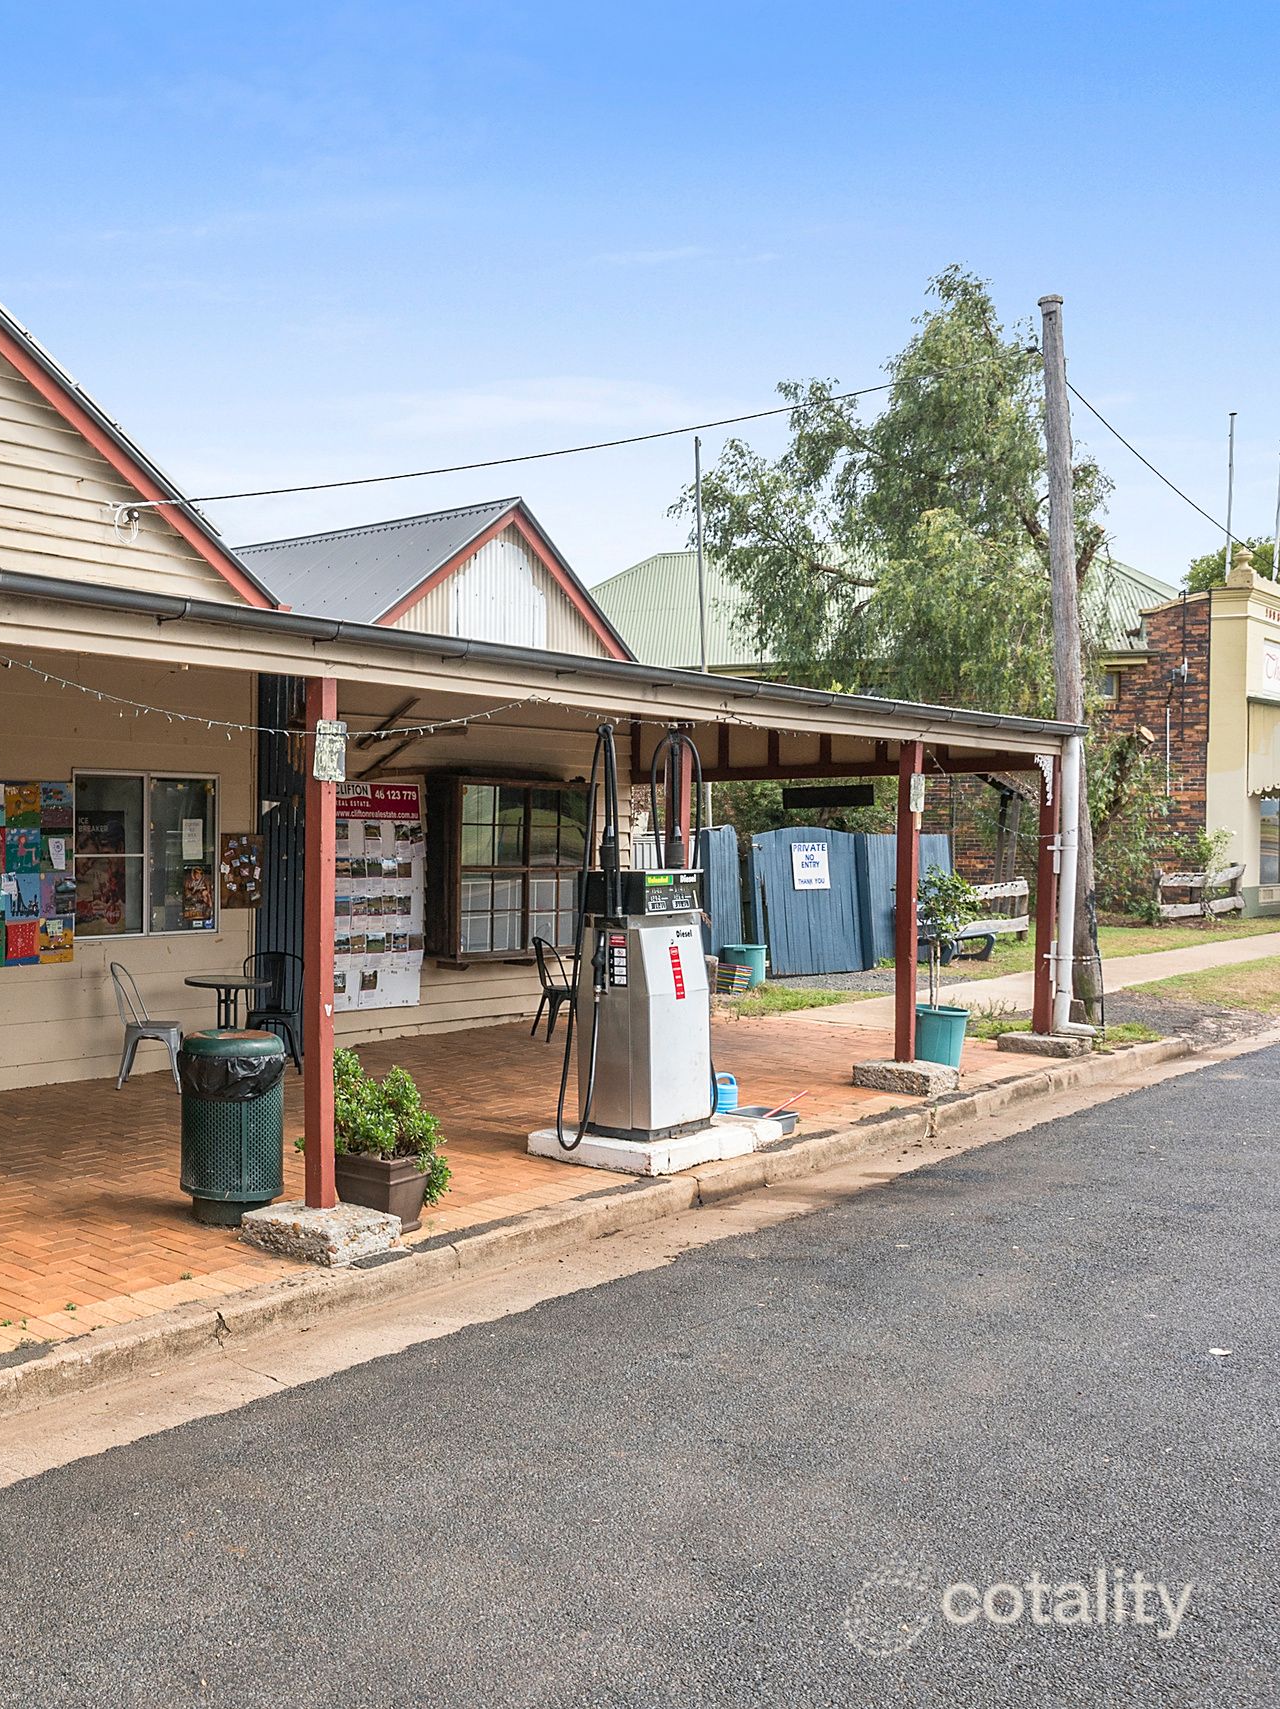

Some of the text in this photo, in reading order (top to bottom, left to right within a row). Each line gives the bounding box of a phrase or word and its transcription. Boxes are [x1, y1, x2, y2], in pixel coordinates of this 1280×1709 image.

[375, 790, 417, 801] 46 123 779
[78, 825, 109, 833] BREAKER
[793, 843, 826, 852] PRIVATE
[805, 853, 815, 861] NO
[801, 861, 820, 869] ENTRY
[679, 874, 697, 884] Diesel
[675, 929, 693, 938] Diesel
